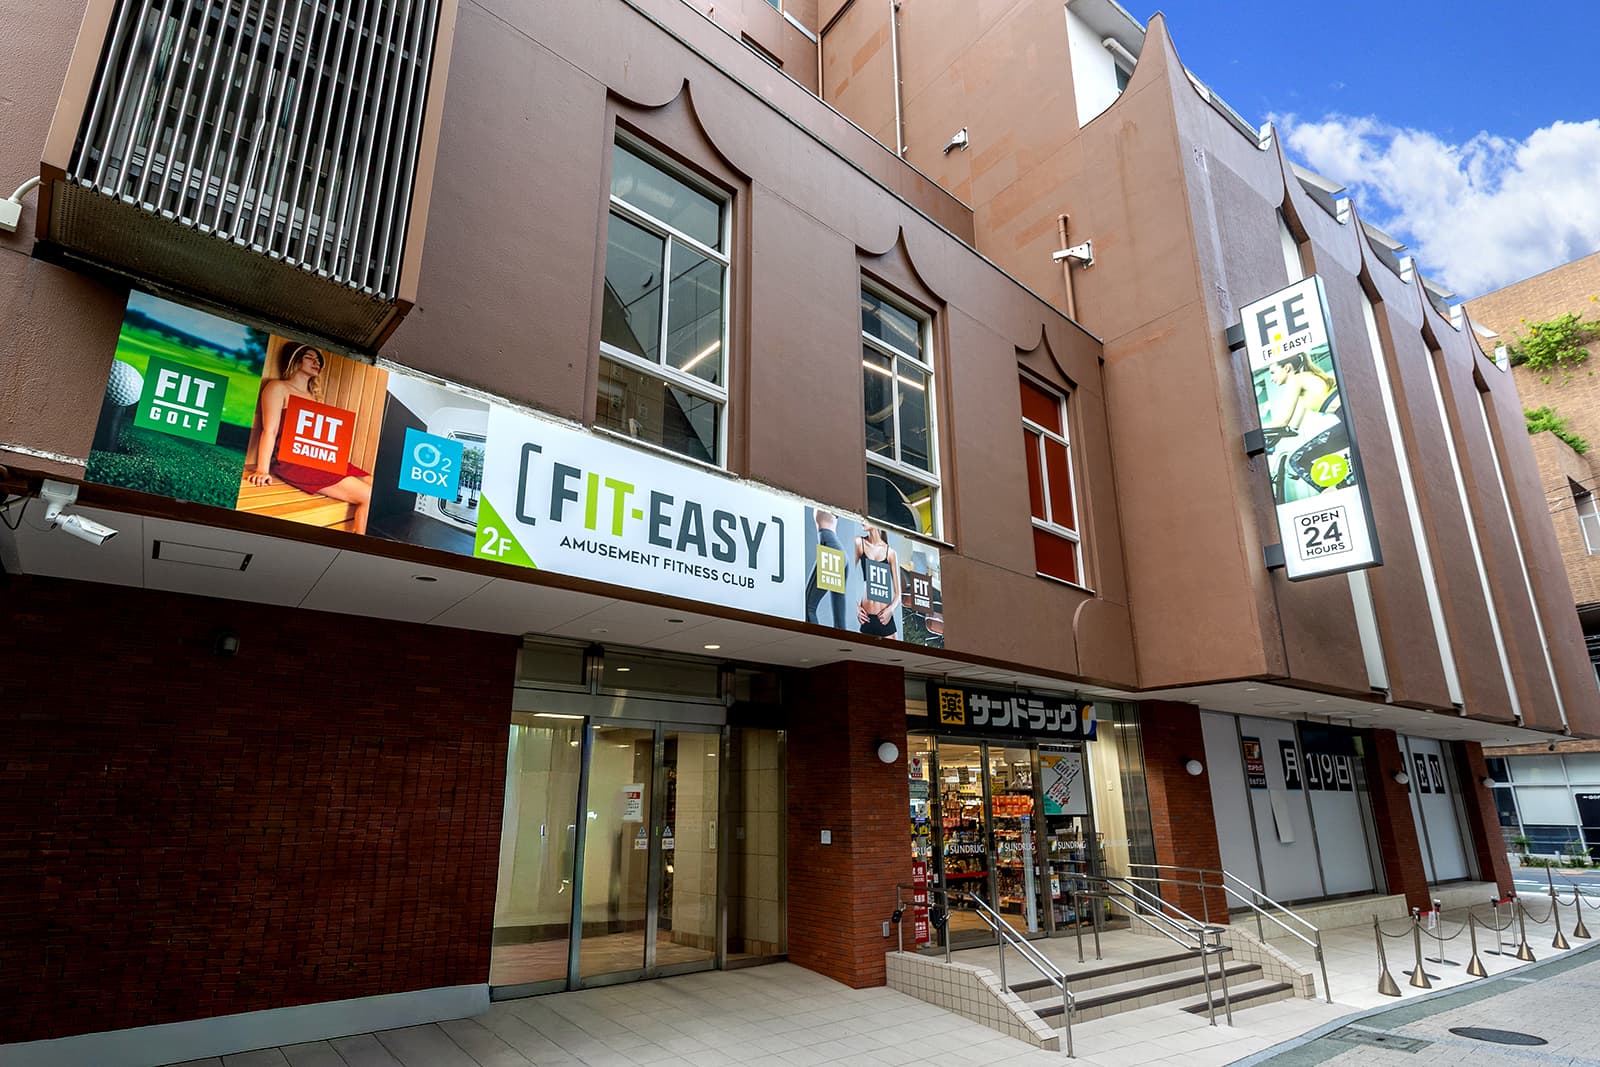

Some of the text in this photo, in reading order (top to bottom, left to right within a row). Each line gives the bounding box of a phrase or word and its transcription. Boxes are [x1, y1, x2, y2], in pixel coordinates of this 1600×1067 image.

[154, 368, 216, 408] FIT
[149, 406, 209, 431] GOLF
[296, 409, 344, 443] FIT
[292, 441, 337, 464] SAUNA
[410, 466, 449, 488] BOX
[1316, 461, 1343, 482] 2F
[1301, 511, 1340, 527] OPEN
[480, 526, 513, 557] 2F
[1303, 521, 1343, 548] 24
[1306, 542, 1346, 557] HOURS
[559, 535, 756, 589] AMUSEMENT FITNESS CLUB
[820, 551, 842, 578] FIT
[821, 574, 843, 588] CHAIR
[869, 564, 889, 588] FIT
[913, 578, 930, 597] FIT
[870, 587, 889, 599] SHAPE
[941, 690, 1078, 733] 薬 サンドラッグ
[949, 843, 986, 855] SUNDRUG
[1057, 840, 1087, 850] SUNDRUG
